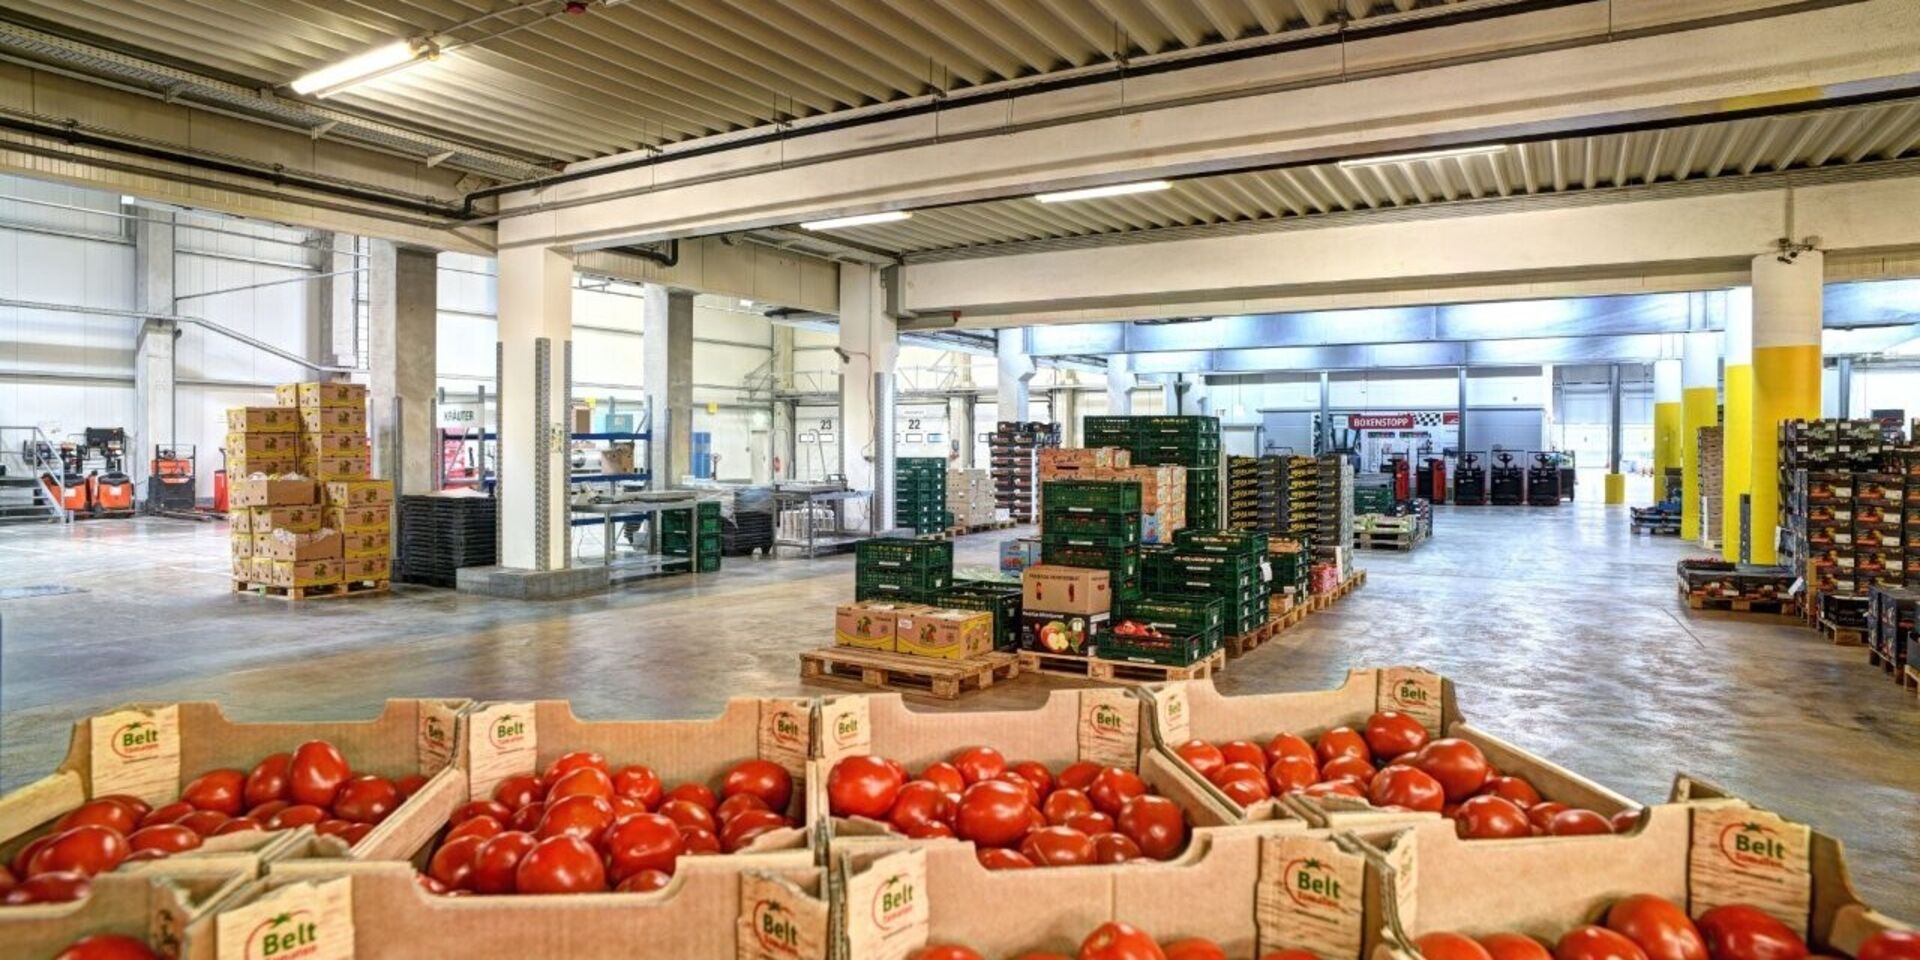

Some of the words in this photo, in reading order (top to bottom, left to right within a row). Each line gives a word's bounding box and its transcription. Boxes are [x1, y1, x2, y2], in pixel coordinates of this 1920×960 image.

[820, 419, 832, 430] 23
[908, 419, 921, 430] 22
[1353, 417, 1409, 428] BOXENSTOPP
[1400, 686, 1427, 701] Belt
[838, 719, 858, 735] Belt
[1096, 711, 1121, 727] Belt
[497, 722, 524, 738] Belt
[777, 719, 799, 736] Belt
[123, 729, 159, 748] Belt
[1735, 833, 1786, 860] Belt
[1297, 870, 1340, 899] Belt
[882, 883, 914, 913] Belt
[763, 912, 799, 947] Belt
[262, 922, 317, 957] Belt
